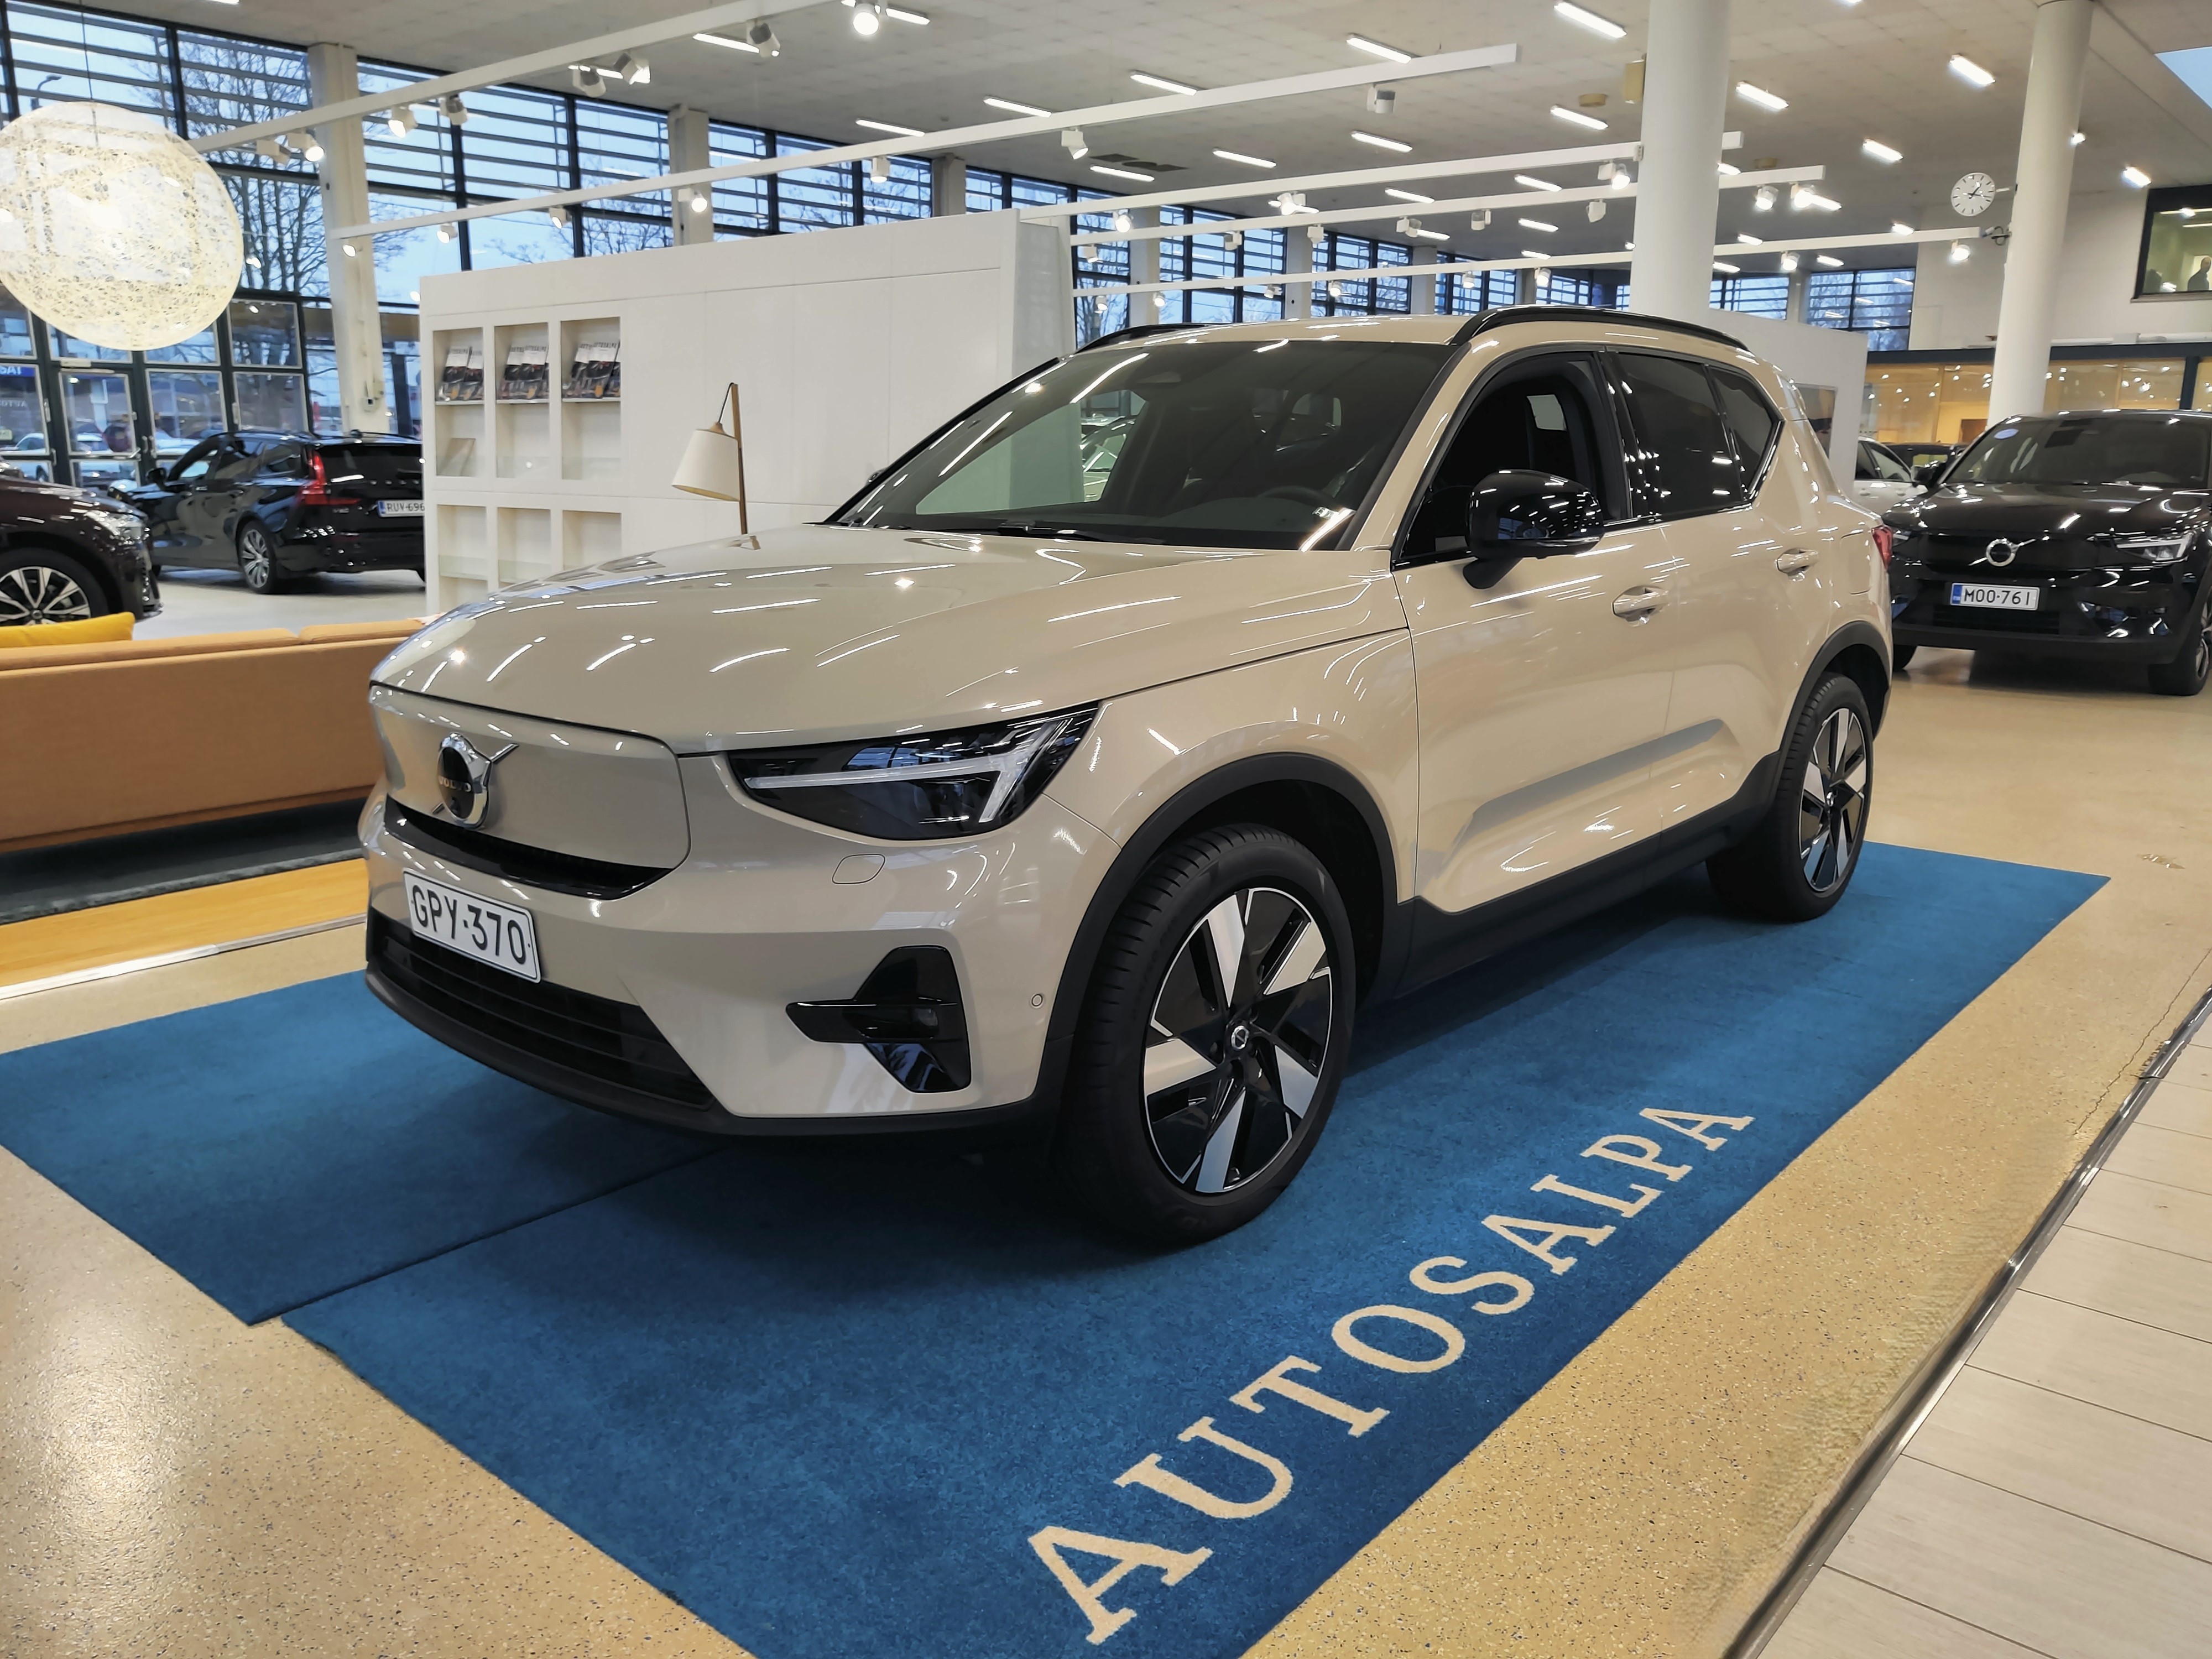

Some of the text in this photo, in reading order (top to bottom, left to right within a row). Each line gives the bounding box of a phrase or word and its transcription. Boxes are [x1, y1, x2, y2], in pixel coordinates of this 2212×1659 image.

[387, 503, 425, 512] RUV-696
[413, 885, 525, 964] GPY-370
[1028, 1108, 1755, 1645] AUTOSALPA
